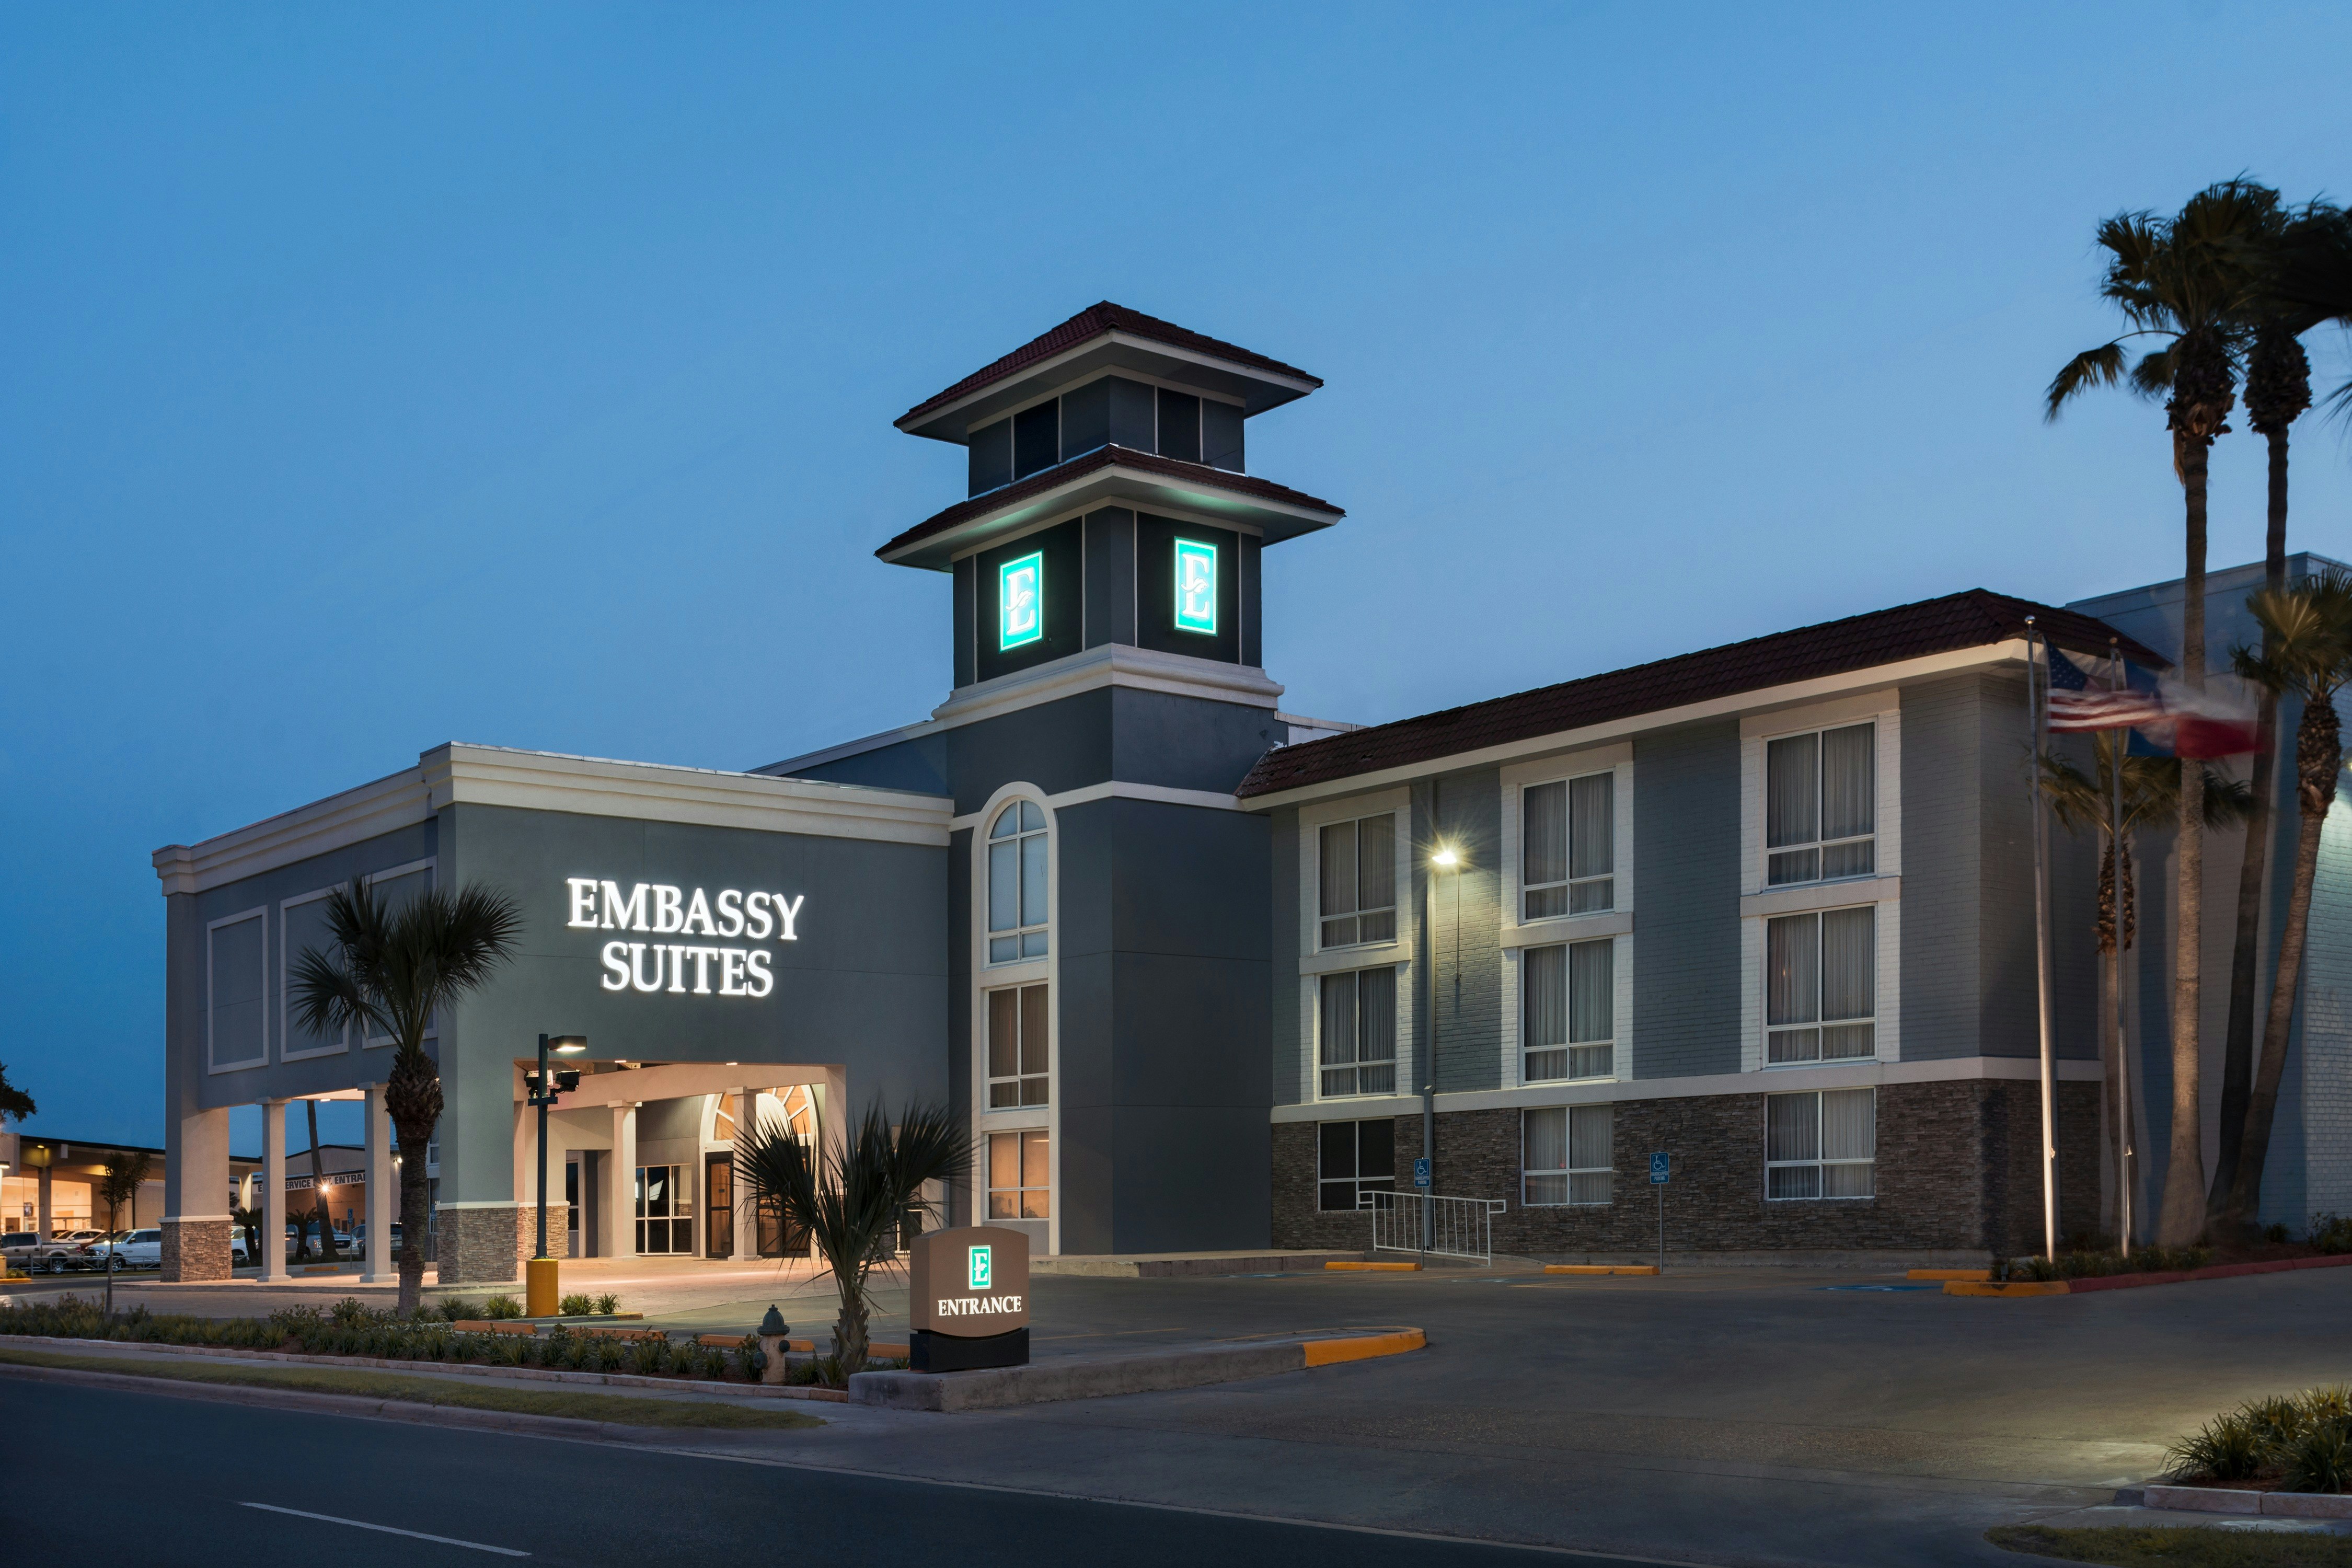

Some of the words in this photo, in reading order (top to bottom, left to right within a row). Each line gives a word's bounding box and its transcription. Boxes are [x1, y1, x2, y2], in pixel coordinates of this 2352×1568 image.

[1005, 567, 1034, 636] E
[1181, 554, 1209, 619] E
[565, 877, 805, 941] EMBASSY
[600, 941, 775, 998] SUITES
[285, 1180, 311, 1190] ERVICE
[335, 1174, 365, 1184] ENTRA
[974, 1252, 988, 1282] E
[937, 1296, 1022, 1316] ENTRANCE
